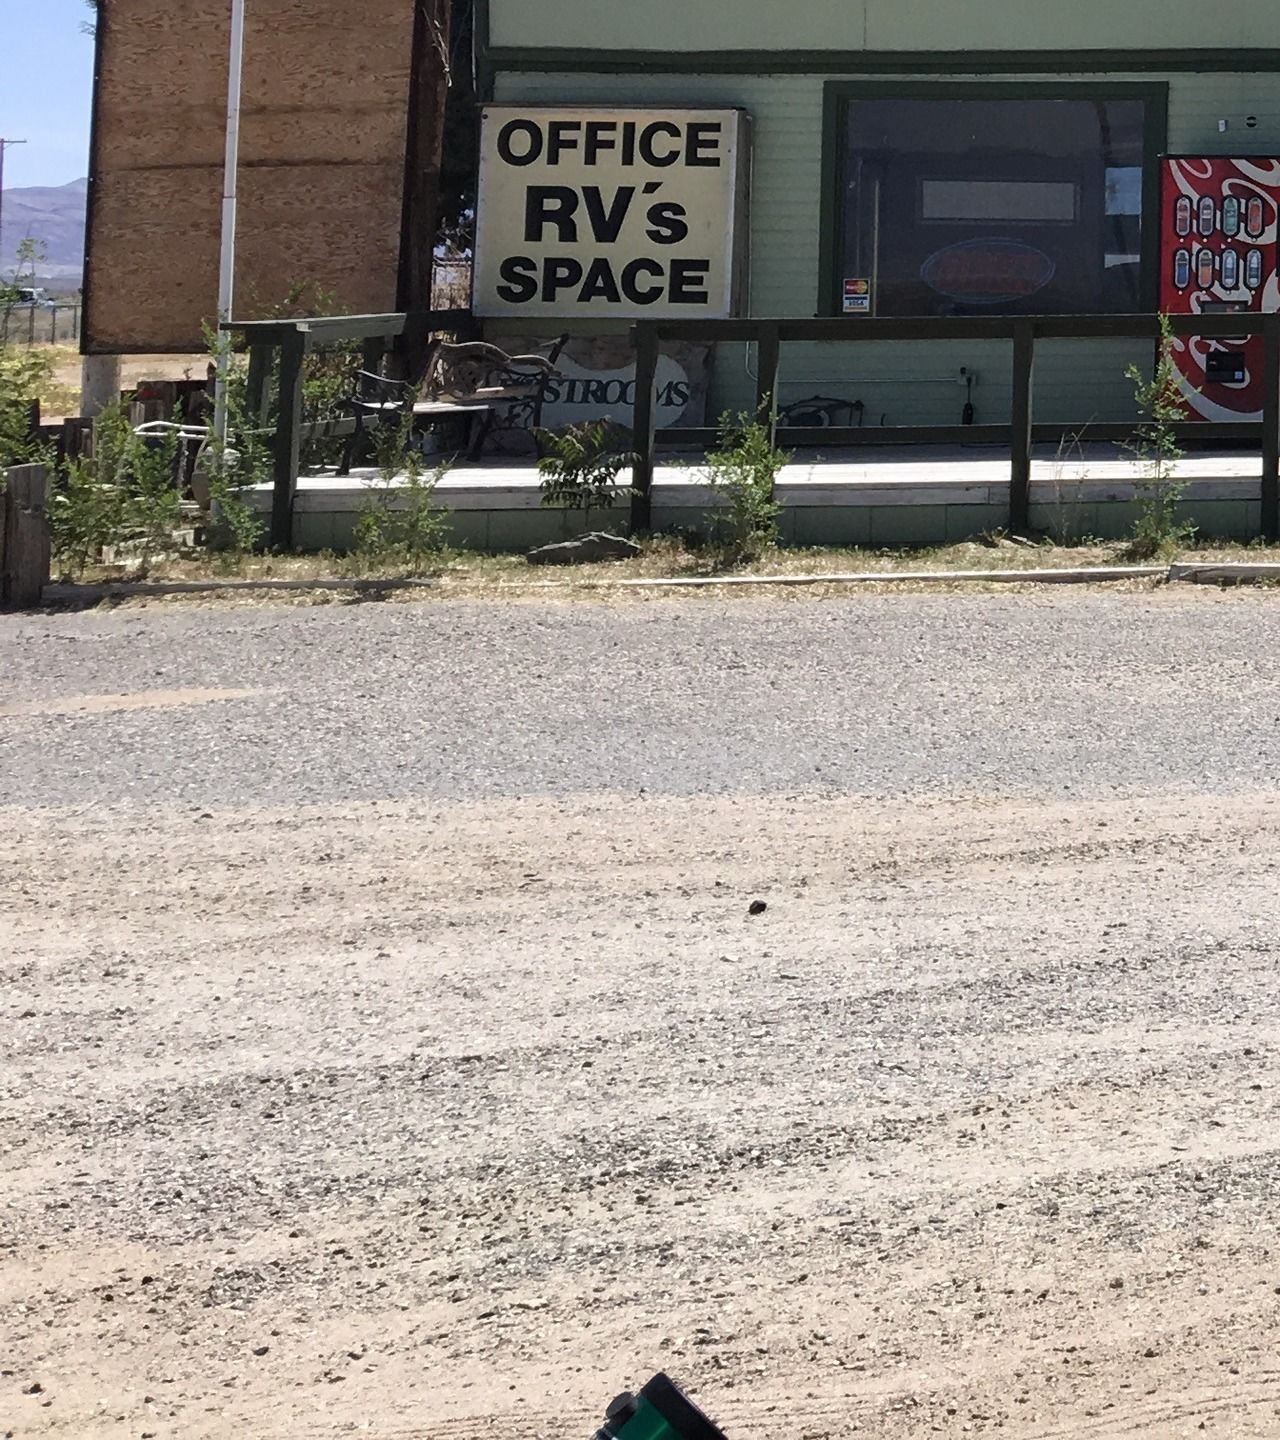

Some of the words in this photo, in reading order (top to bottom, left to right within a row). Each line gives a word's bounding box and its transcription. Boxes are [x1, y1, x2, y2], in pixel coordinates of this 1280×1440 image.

[497, 119, 722, 167] OFFICE
[524, 181, 689, 245] RV's
[496, 256, 709, 304] SPACE
